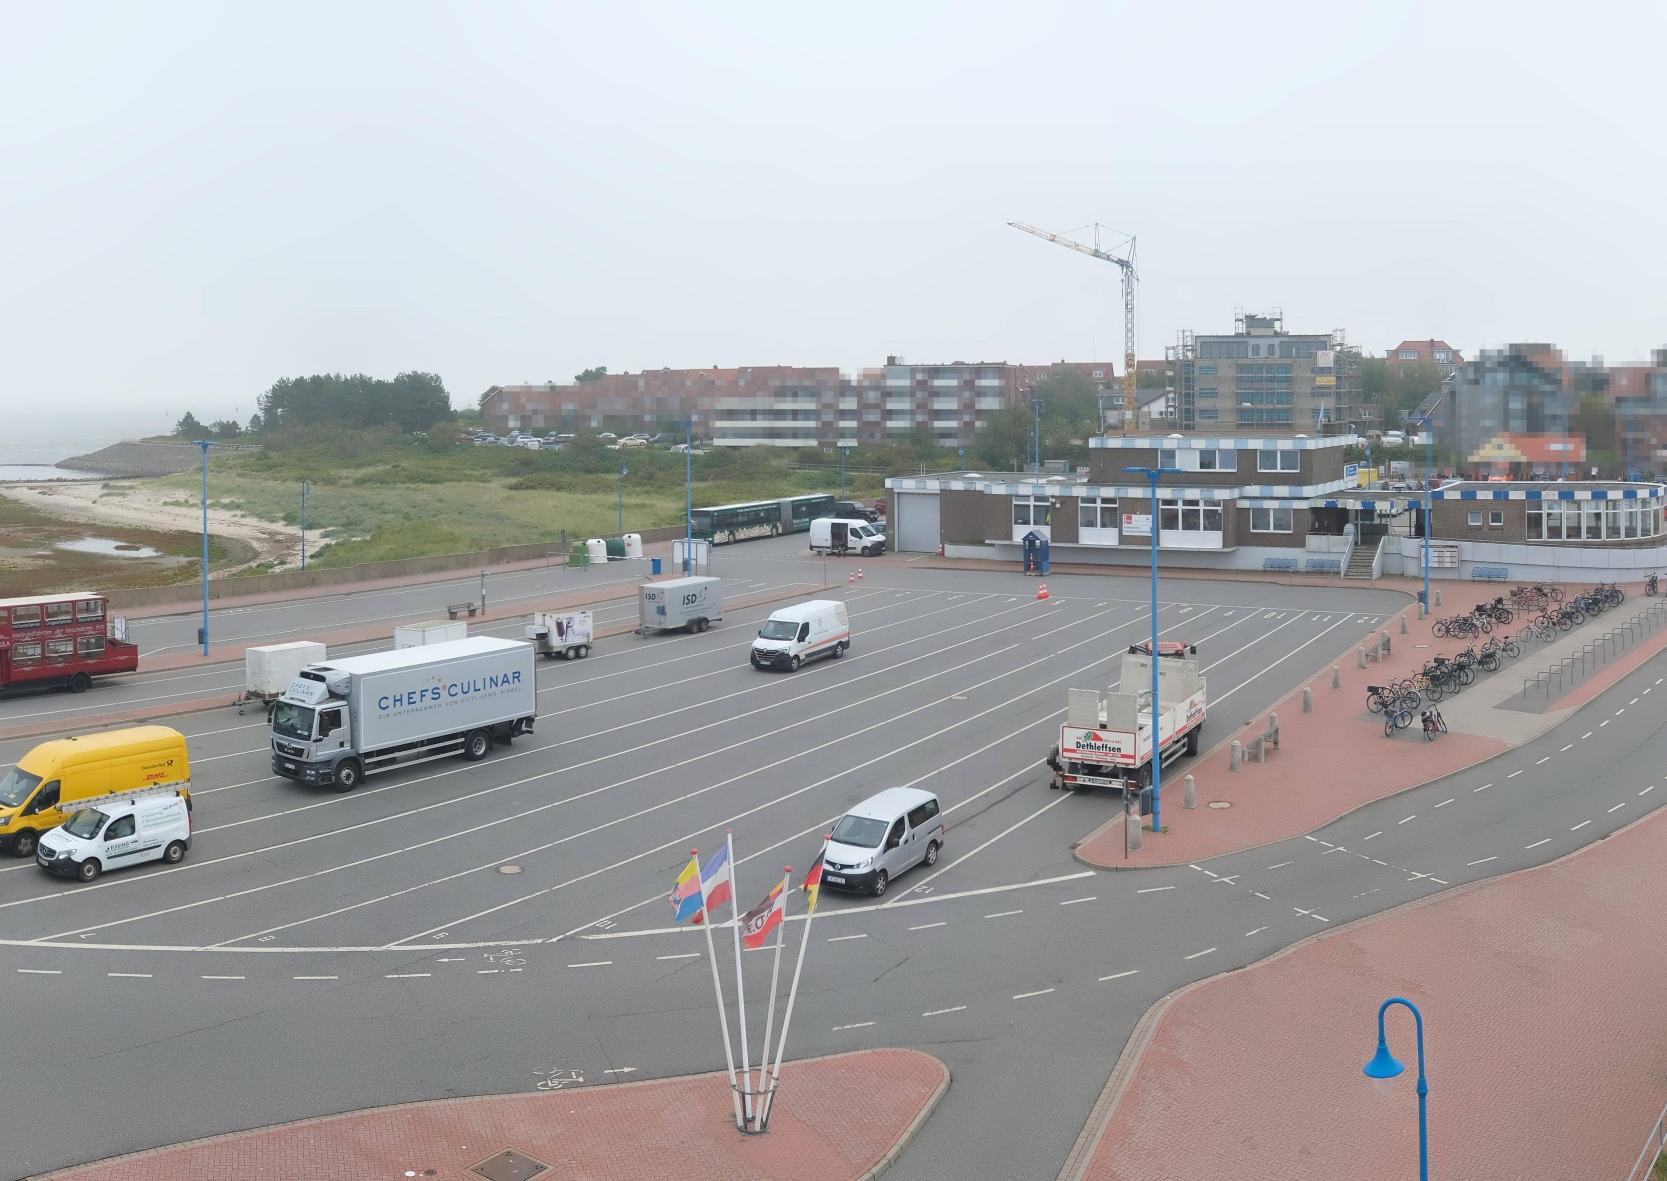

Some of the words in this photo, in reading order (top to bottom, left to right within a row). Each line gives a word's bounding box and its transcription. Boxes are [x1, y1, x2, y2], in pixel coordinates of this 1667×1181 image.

[645, 592, 657, 600] ISD
[682, 593, 697, 606] ISD
[1311, 614, 1332, 622] 11
[66, 626, 94, 634] besonderen
[291, 682, 311, 691] CHEFS
[378, 686, 442, 711] CHEFS
[447, 670, 522, 698] CULINAR
[288, 686, 314, 697] CULINAR
[393, 703, 443, 718] UNTERNEHMEN
[444, 699, 459, 707] VON
[1076, 741, 1122, 754] Dethleffsen
[145, 772, 167, 781] DHL
[914, 885, 935, 894] 12
